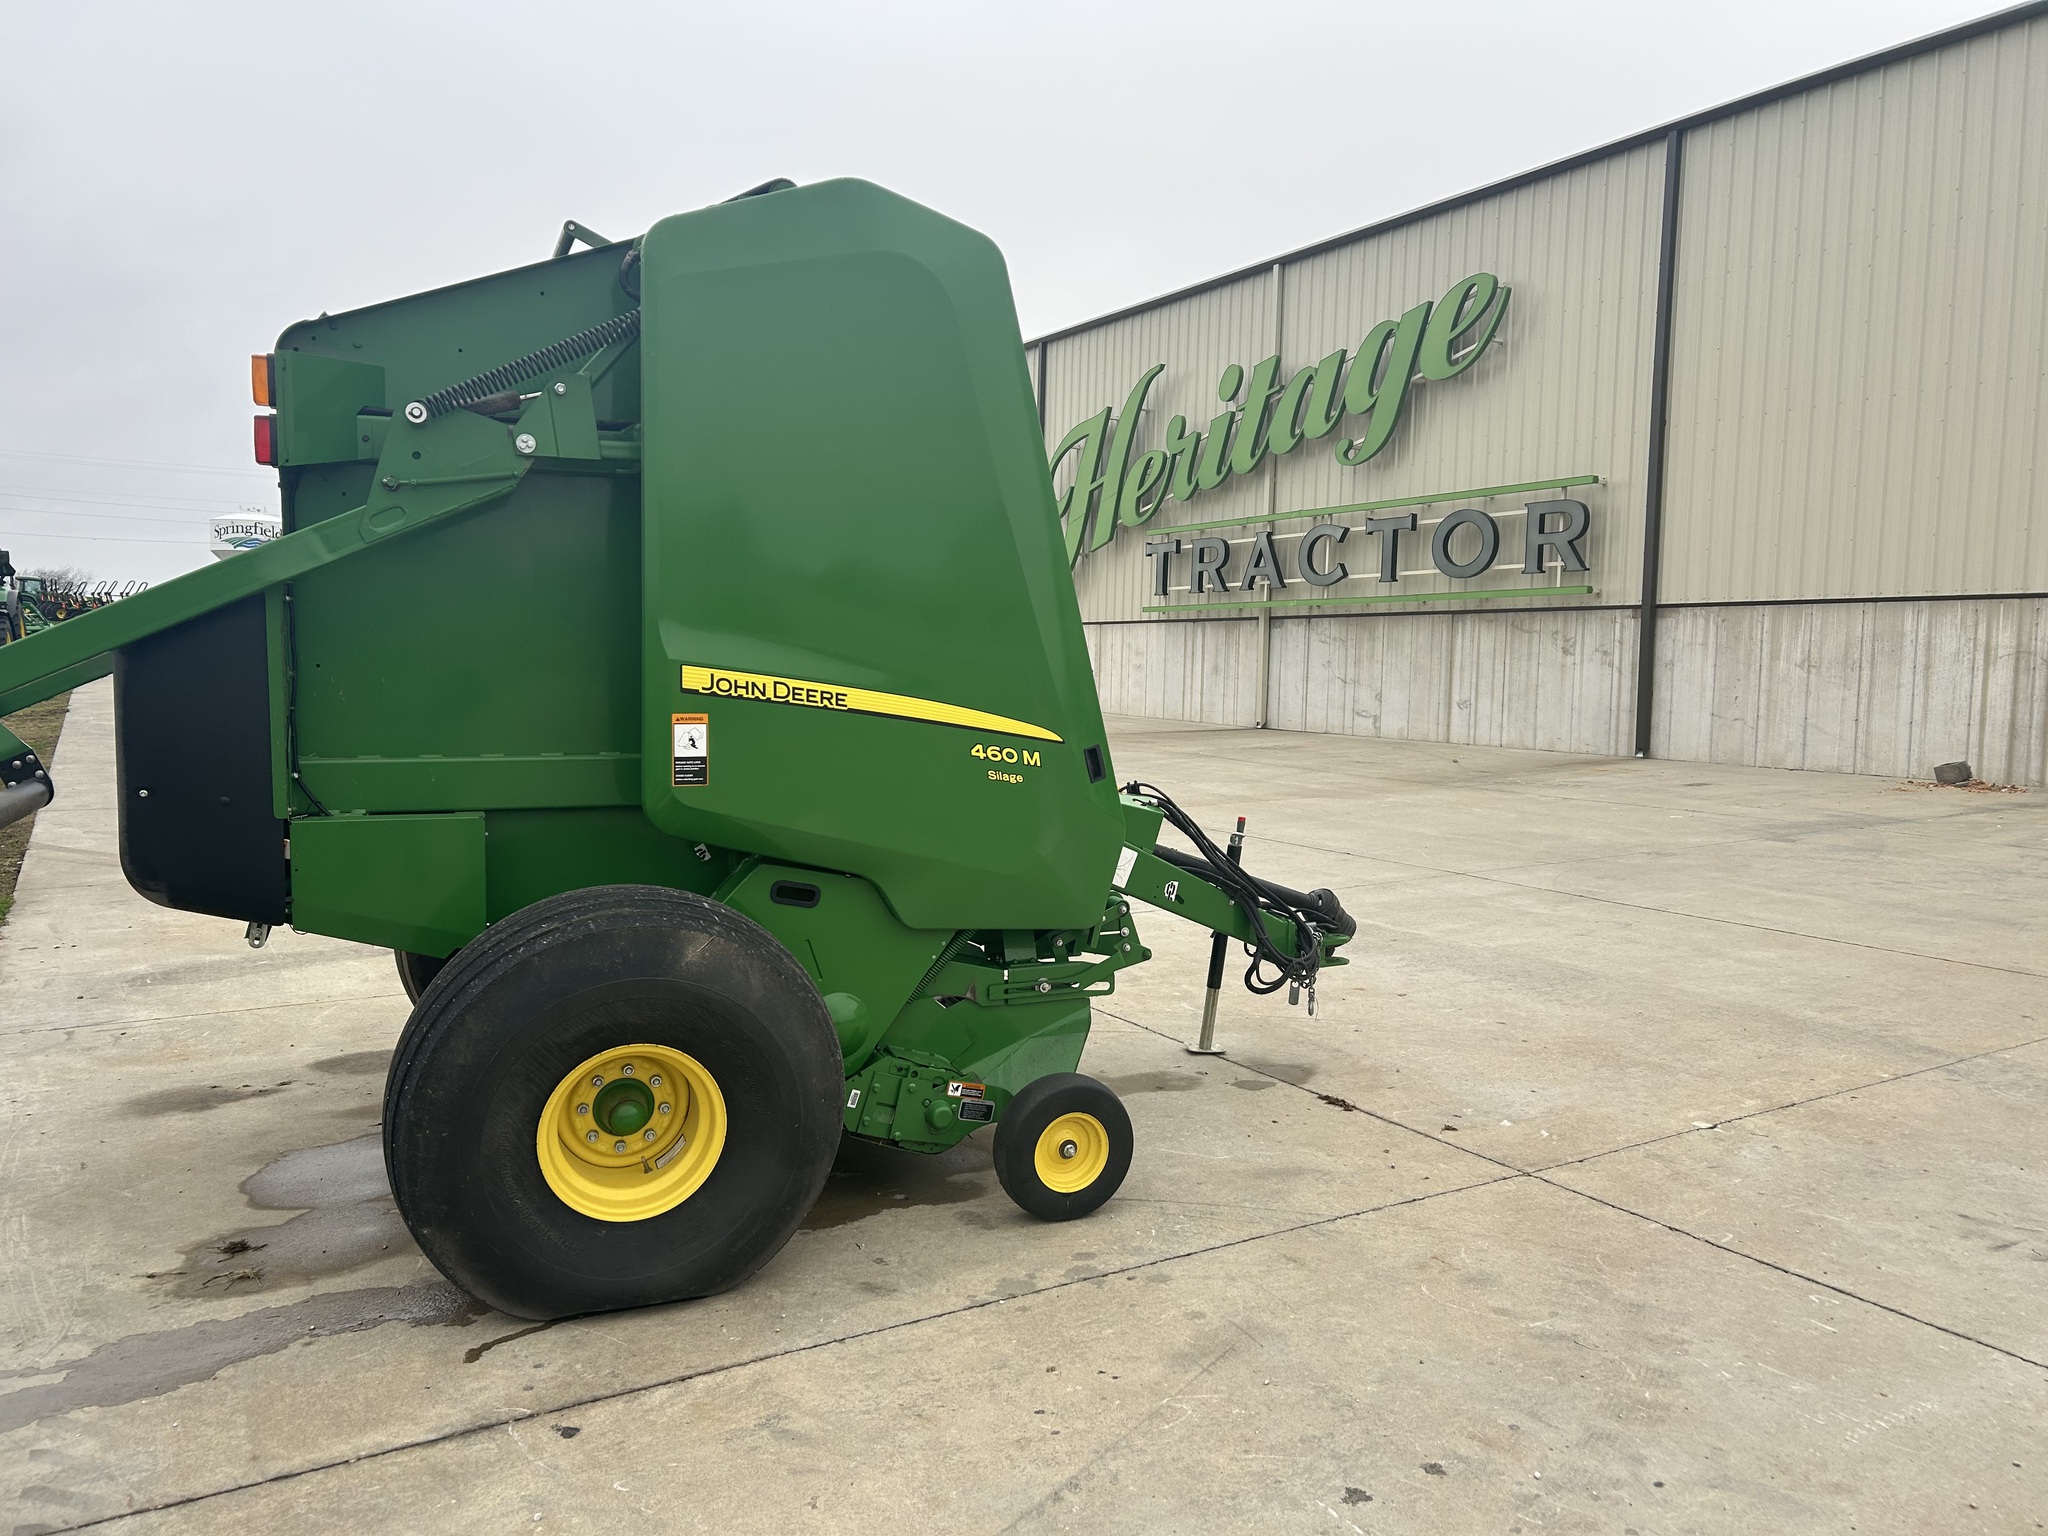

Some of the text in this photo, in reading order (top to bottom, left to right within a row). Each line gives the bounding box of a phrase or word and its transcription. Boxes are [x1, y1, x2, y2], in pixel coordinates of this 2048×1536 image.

[1050, 272, 1512, 571] Heritage
[213, 521, 283, 540] Springfield
[1146, 499, 1590, 596] TRACTOR
[702, 673, 848, 707] JOHN DEERE
[970, 743, 1041, 767] 460 M
[987, 769, 1024, 784] Silage
